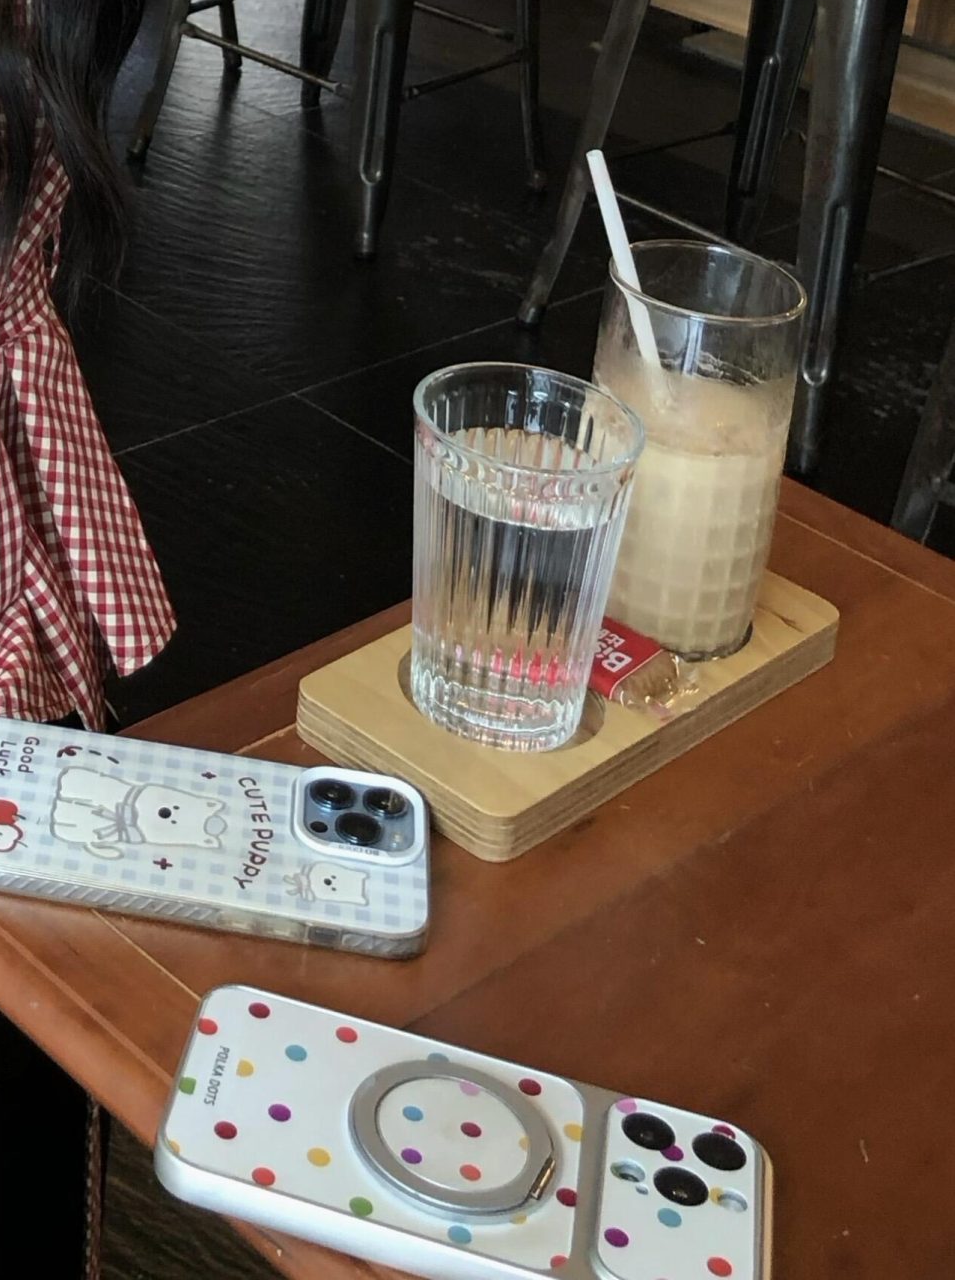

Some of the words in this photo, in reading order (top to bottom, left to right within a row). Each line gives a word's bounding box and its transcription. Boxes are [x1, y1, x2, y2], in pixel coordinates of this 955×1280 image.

[17, 736, 41, 774] Good
[238, 777, 272, 824] CUTE
[211, 1045, 231, 1077] POLKA
[203, 1078, 221, 1106] DOTS
